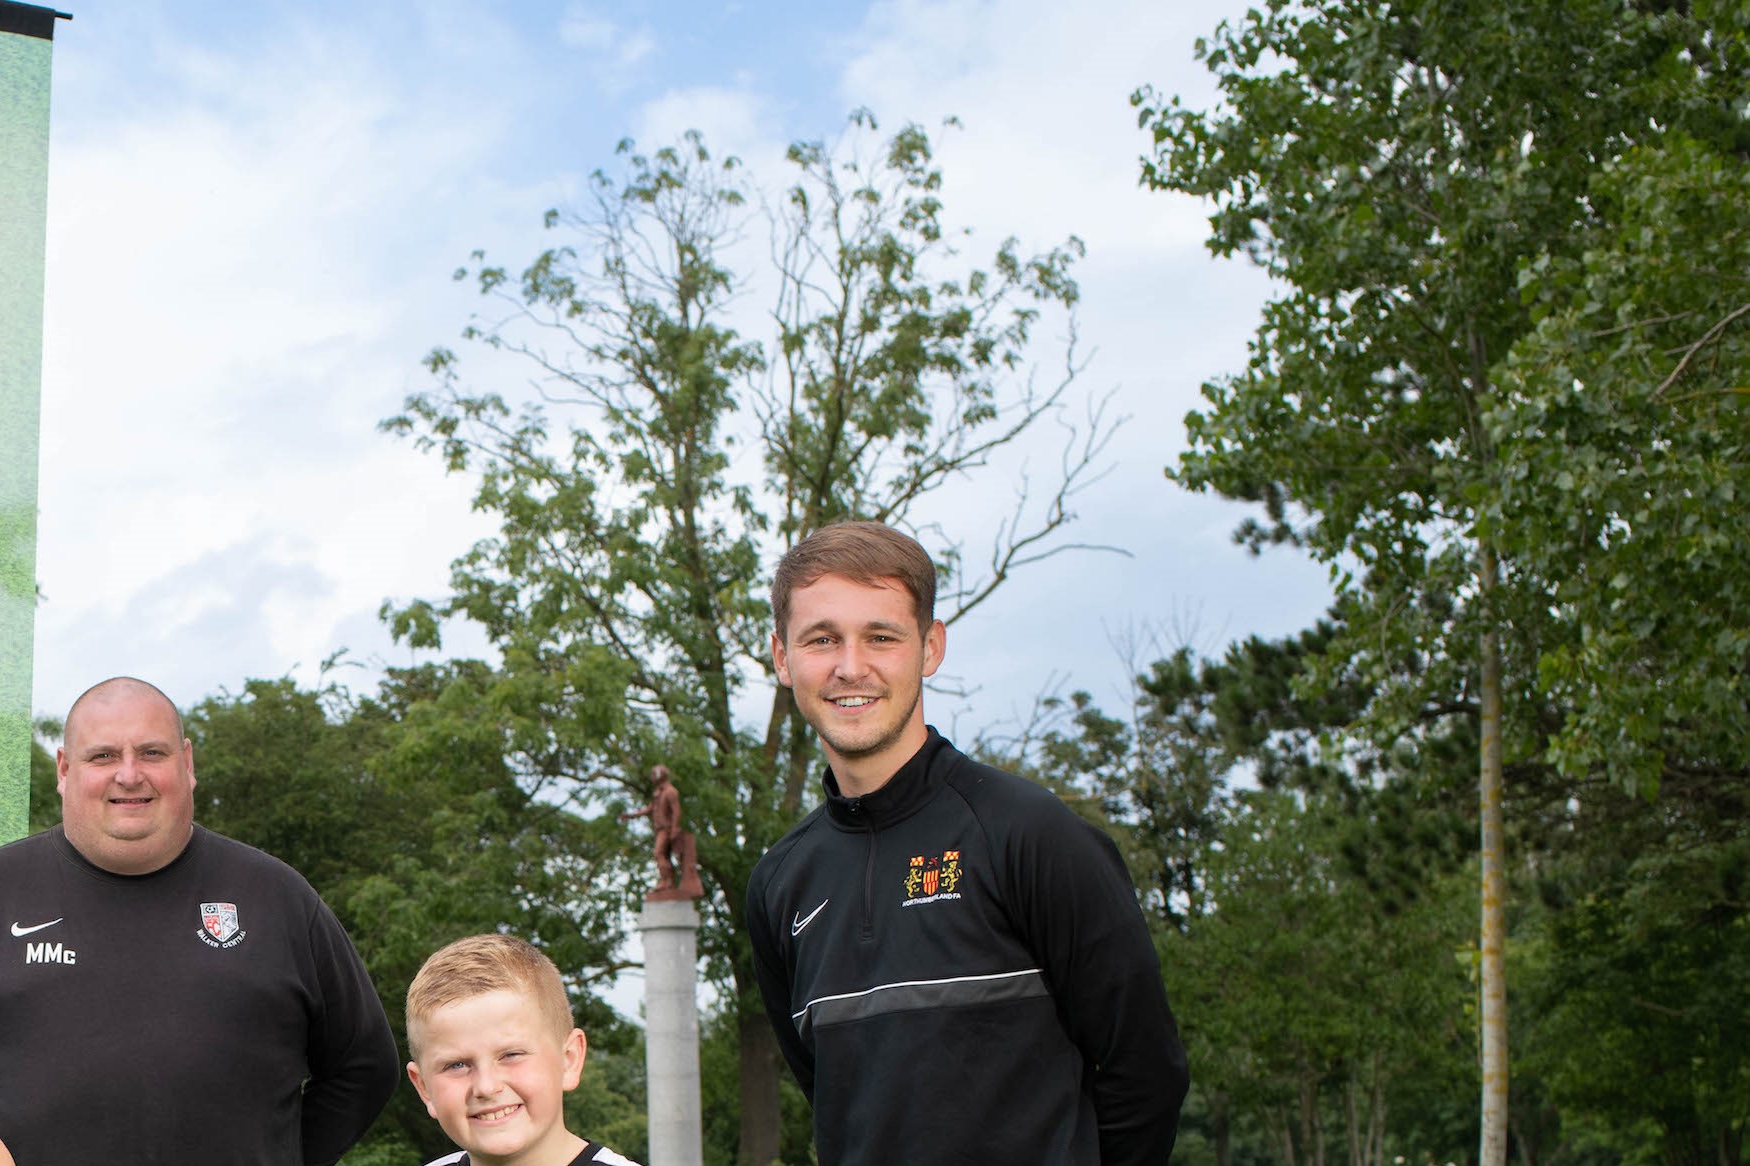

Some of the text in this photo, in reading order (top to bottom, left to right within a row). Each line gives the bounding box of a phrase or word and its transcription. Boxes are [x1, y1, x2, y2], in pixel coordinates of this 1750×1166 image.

[196, 928, 247, 949] WALKER CENTRAL
[26, 942, 76, 965] MMc
